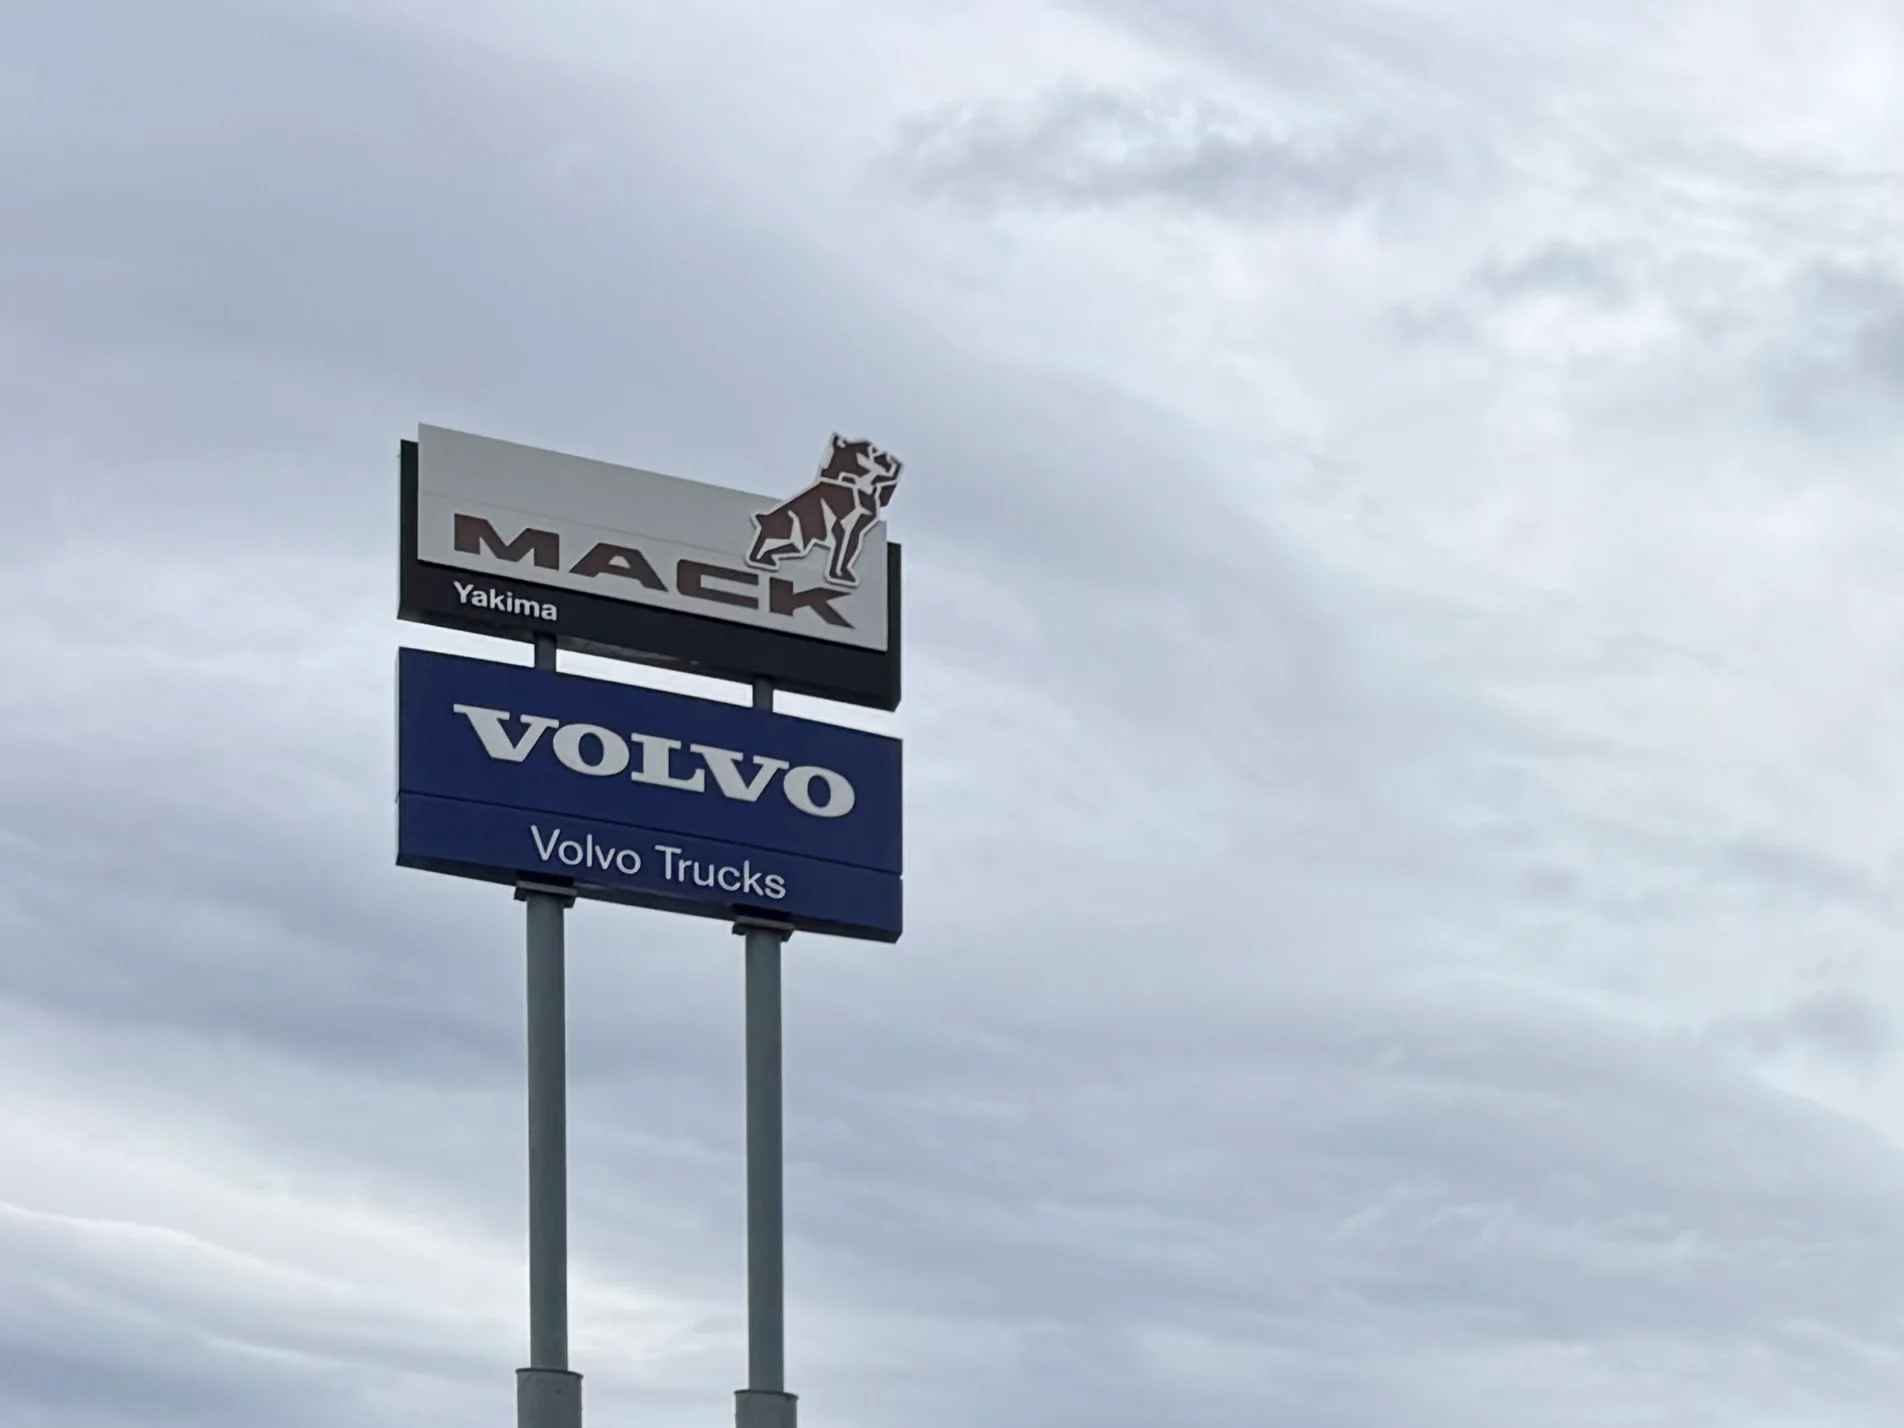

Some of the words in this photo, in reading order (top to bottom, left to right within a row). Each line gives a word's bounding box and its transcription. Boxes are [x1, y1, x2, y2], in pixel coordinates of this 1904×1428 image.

[453, 581, 558, 621] Yakima
[454, 513, 855, 629] MACK
[453, 703, 856, 818] VOLVO
[530, 825, 642, 875] Volvo
[655, 844, 788, 900] Trucks
